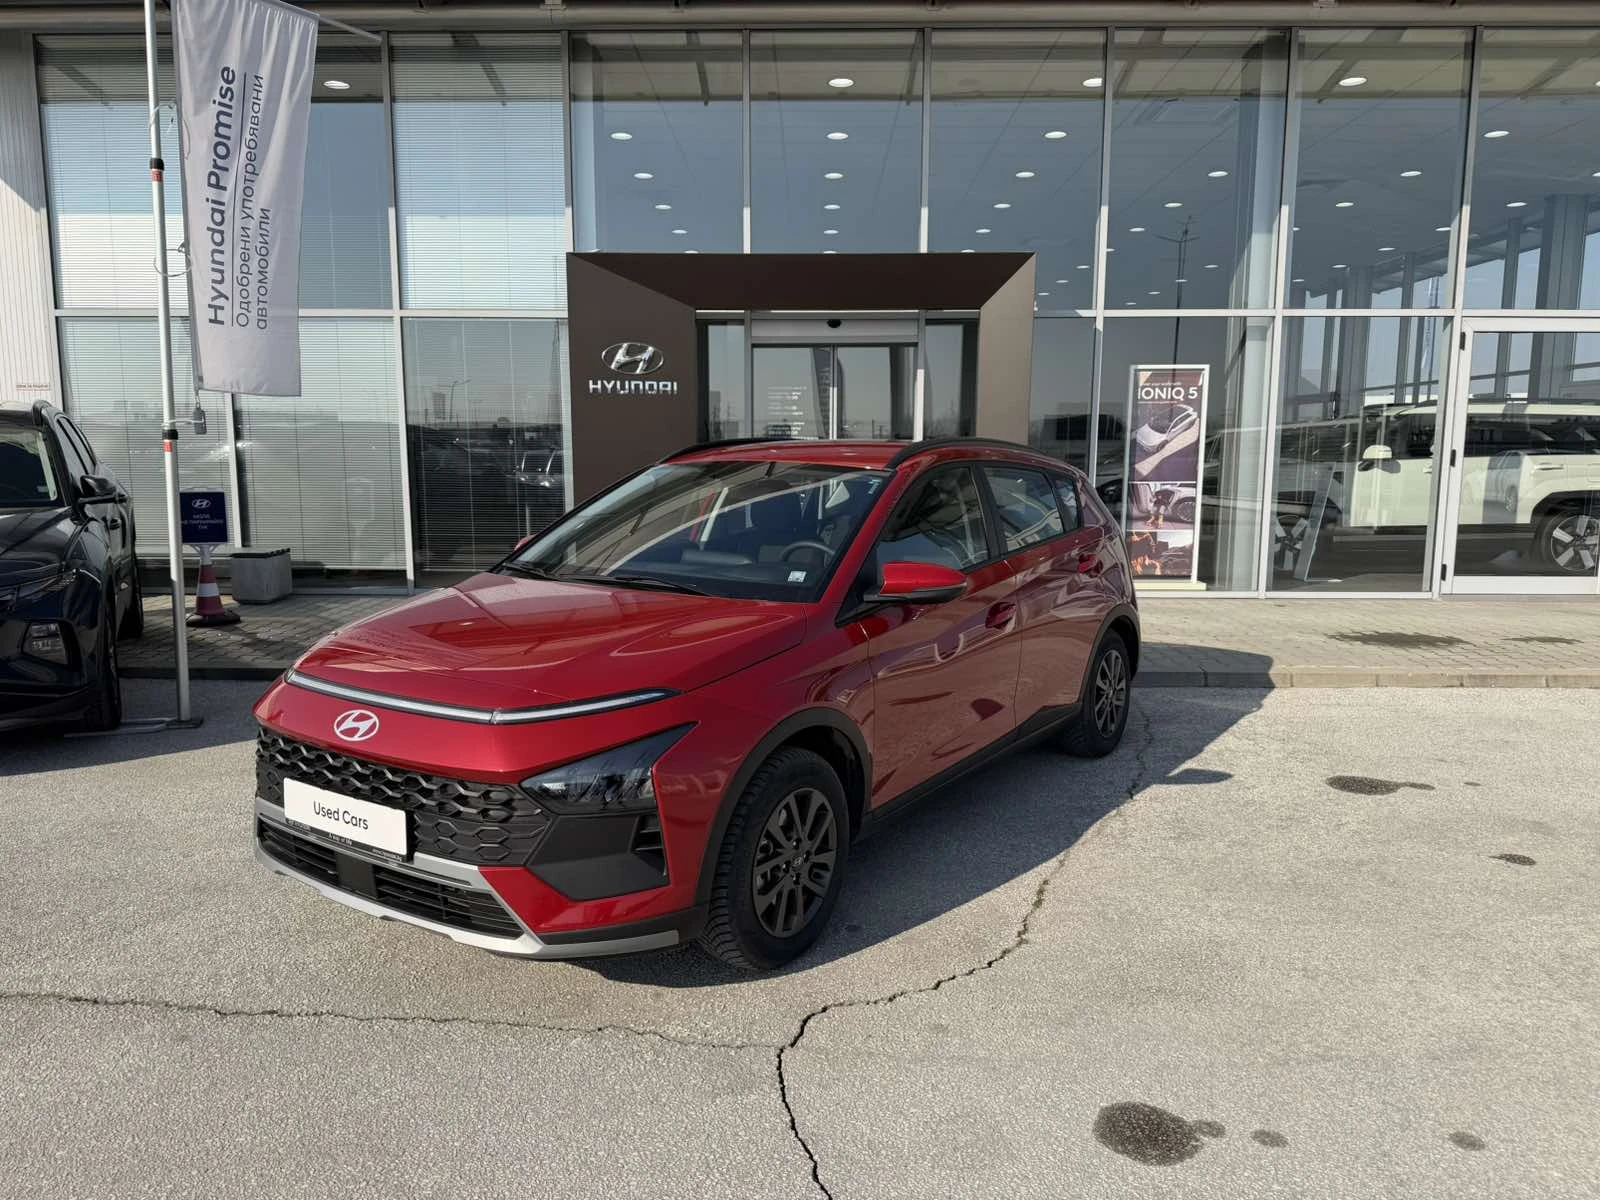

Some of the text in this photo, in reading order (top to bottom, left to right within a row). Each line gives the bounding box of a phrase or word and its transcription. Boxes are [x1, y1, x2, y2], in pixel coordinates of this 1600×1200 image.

[205, 66, 236, 326] Hyundai Promise
[236, 74, 264, 327] Одобрени употребявани
[255, 207, 272, 330] автомобили
[588, 379, 678, 394] HYUNDAI
[1137, 386, 1199, 401] IONIQ 5
[313, 800, 369, 830] Used Cars
